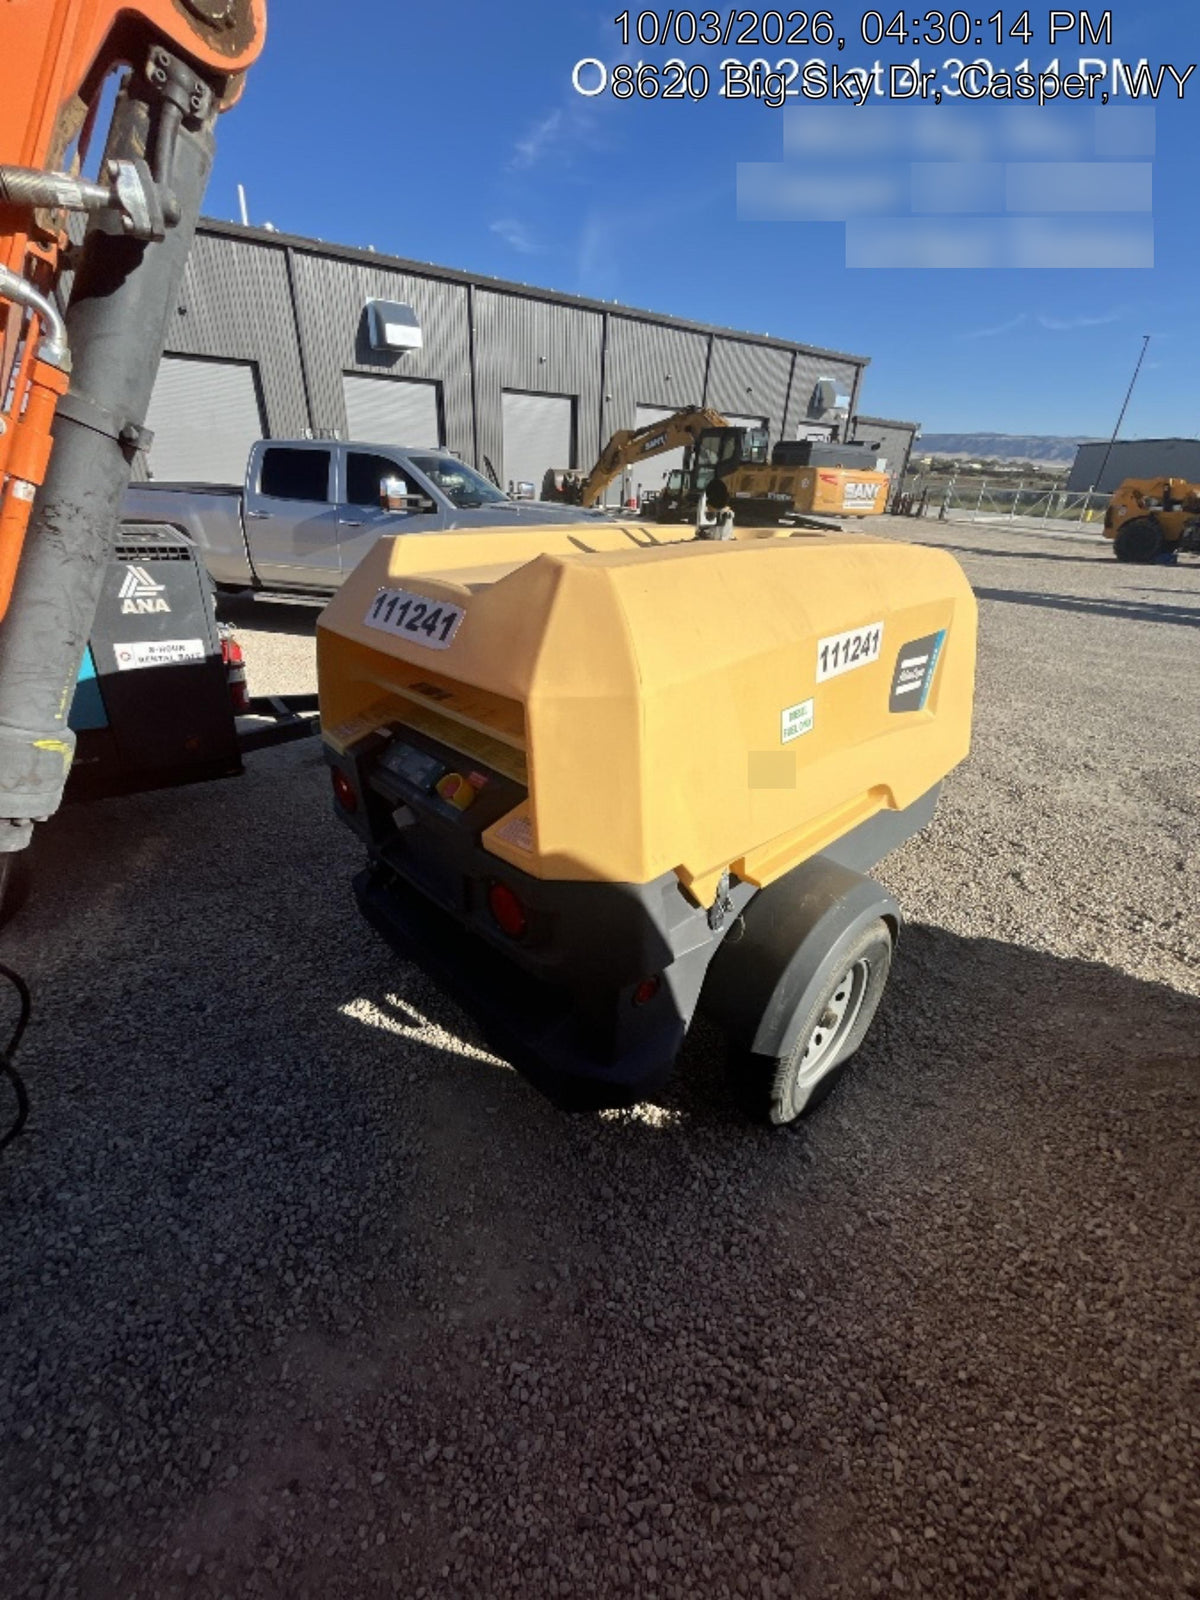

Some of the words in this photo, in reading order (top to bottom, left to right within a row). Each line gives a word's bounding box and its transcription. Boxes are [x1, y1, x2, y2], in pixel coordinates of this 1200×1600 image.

[122, 598, 172, 614] ANA
[372, 593, 458, 642] 111241
[820, 629, 880, 673] 111241
